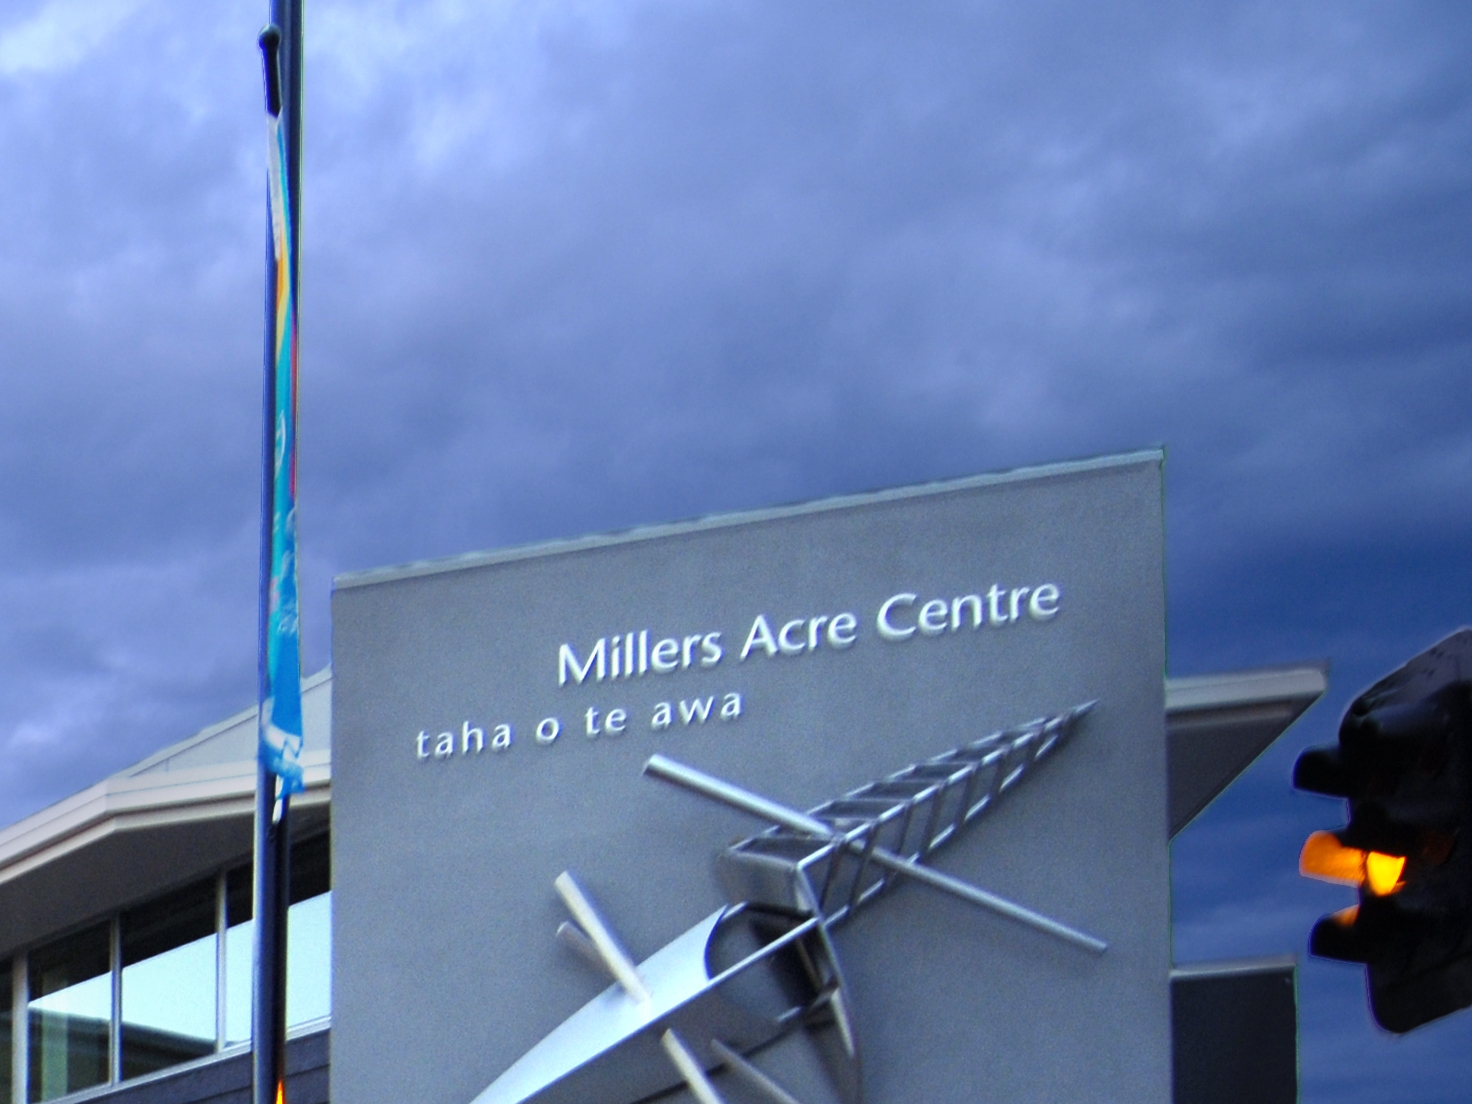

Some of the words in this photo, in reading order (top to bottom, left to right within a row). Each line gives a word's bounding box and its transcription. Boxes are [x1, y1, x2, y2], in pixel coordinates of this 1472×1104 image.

[558, 628, 723, 687] Millers
[739, 613, 857, 661] Acre
[875, 582, 1061, 642] Centre
[416, 720, 513, 760] taha
[535, 716, 561, 745] o
[584, 706, 628, 738] te
[651, 692, 742, 730] awa
